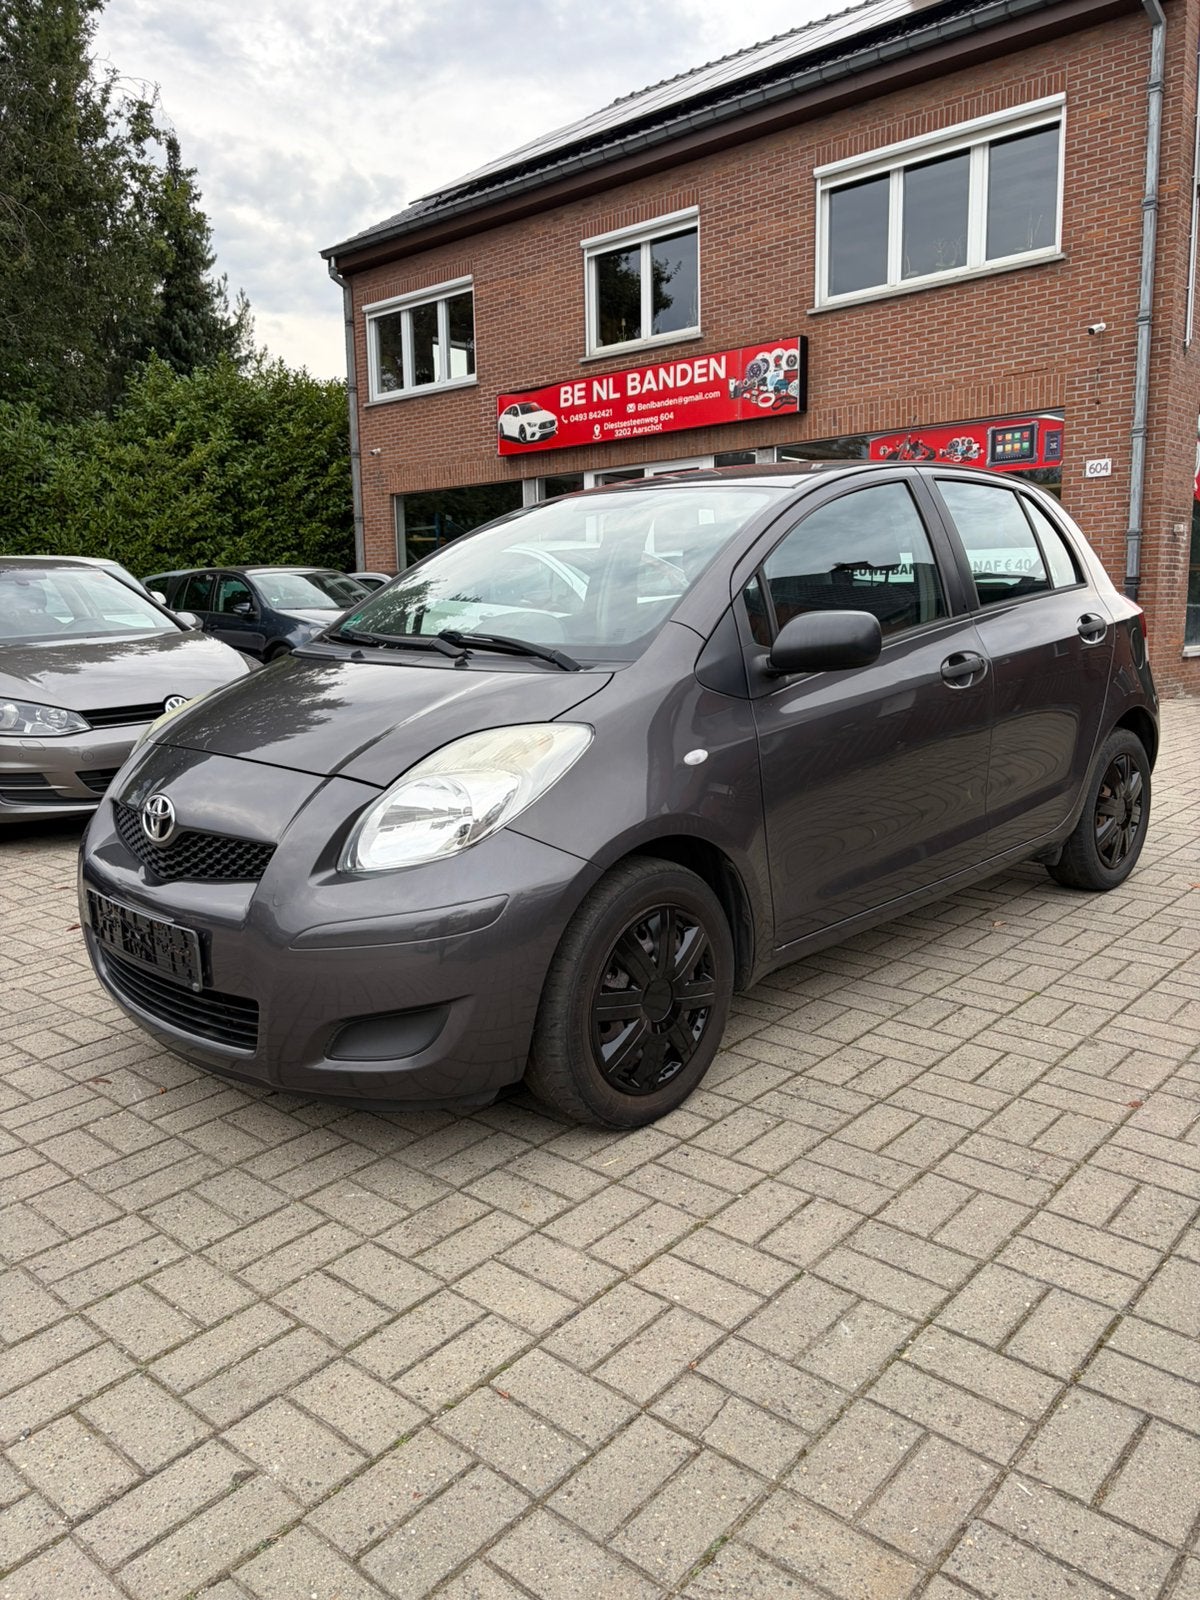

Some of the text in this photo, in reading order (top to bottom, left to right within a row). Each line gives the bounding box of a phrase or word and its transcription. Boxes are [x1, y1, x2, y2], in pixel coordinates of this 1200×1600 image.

[559, 355, 727, 408] BE NL BANDEN
[569, 409, 613, 422] 0493 842421
[659, 411, 674, 421] 604
[614, 423, 663, 437] 3202 Aarschot
[1088, 461, 1109, 475] 604
[1014, 558, 1032, 571] 40
